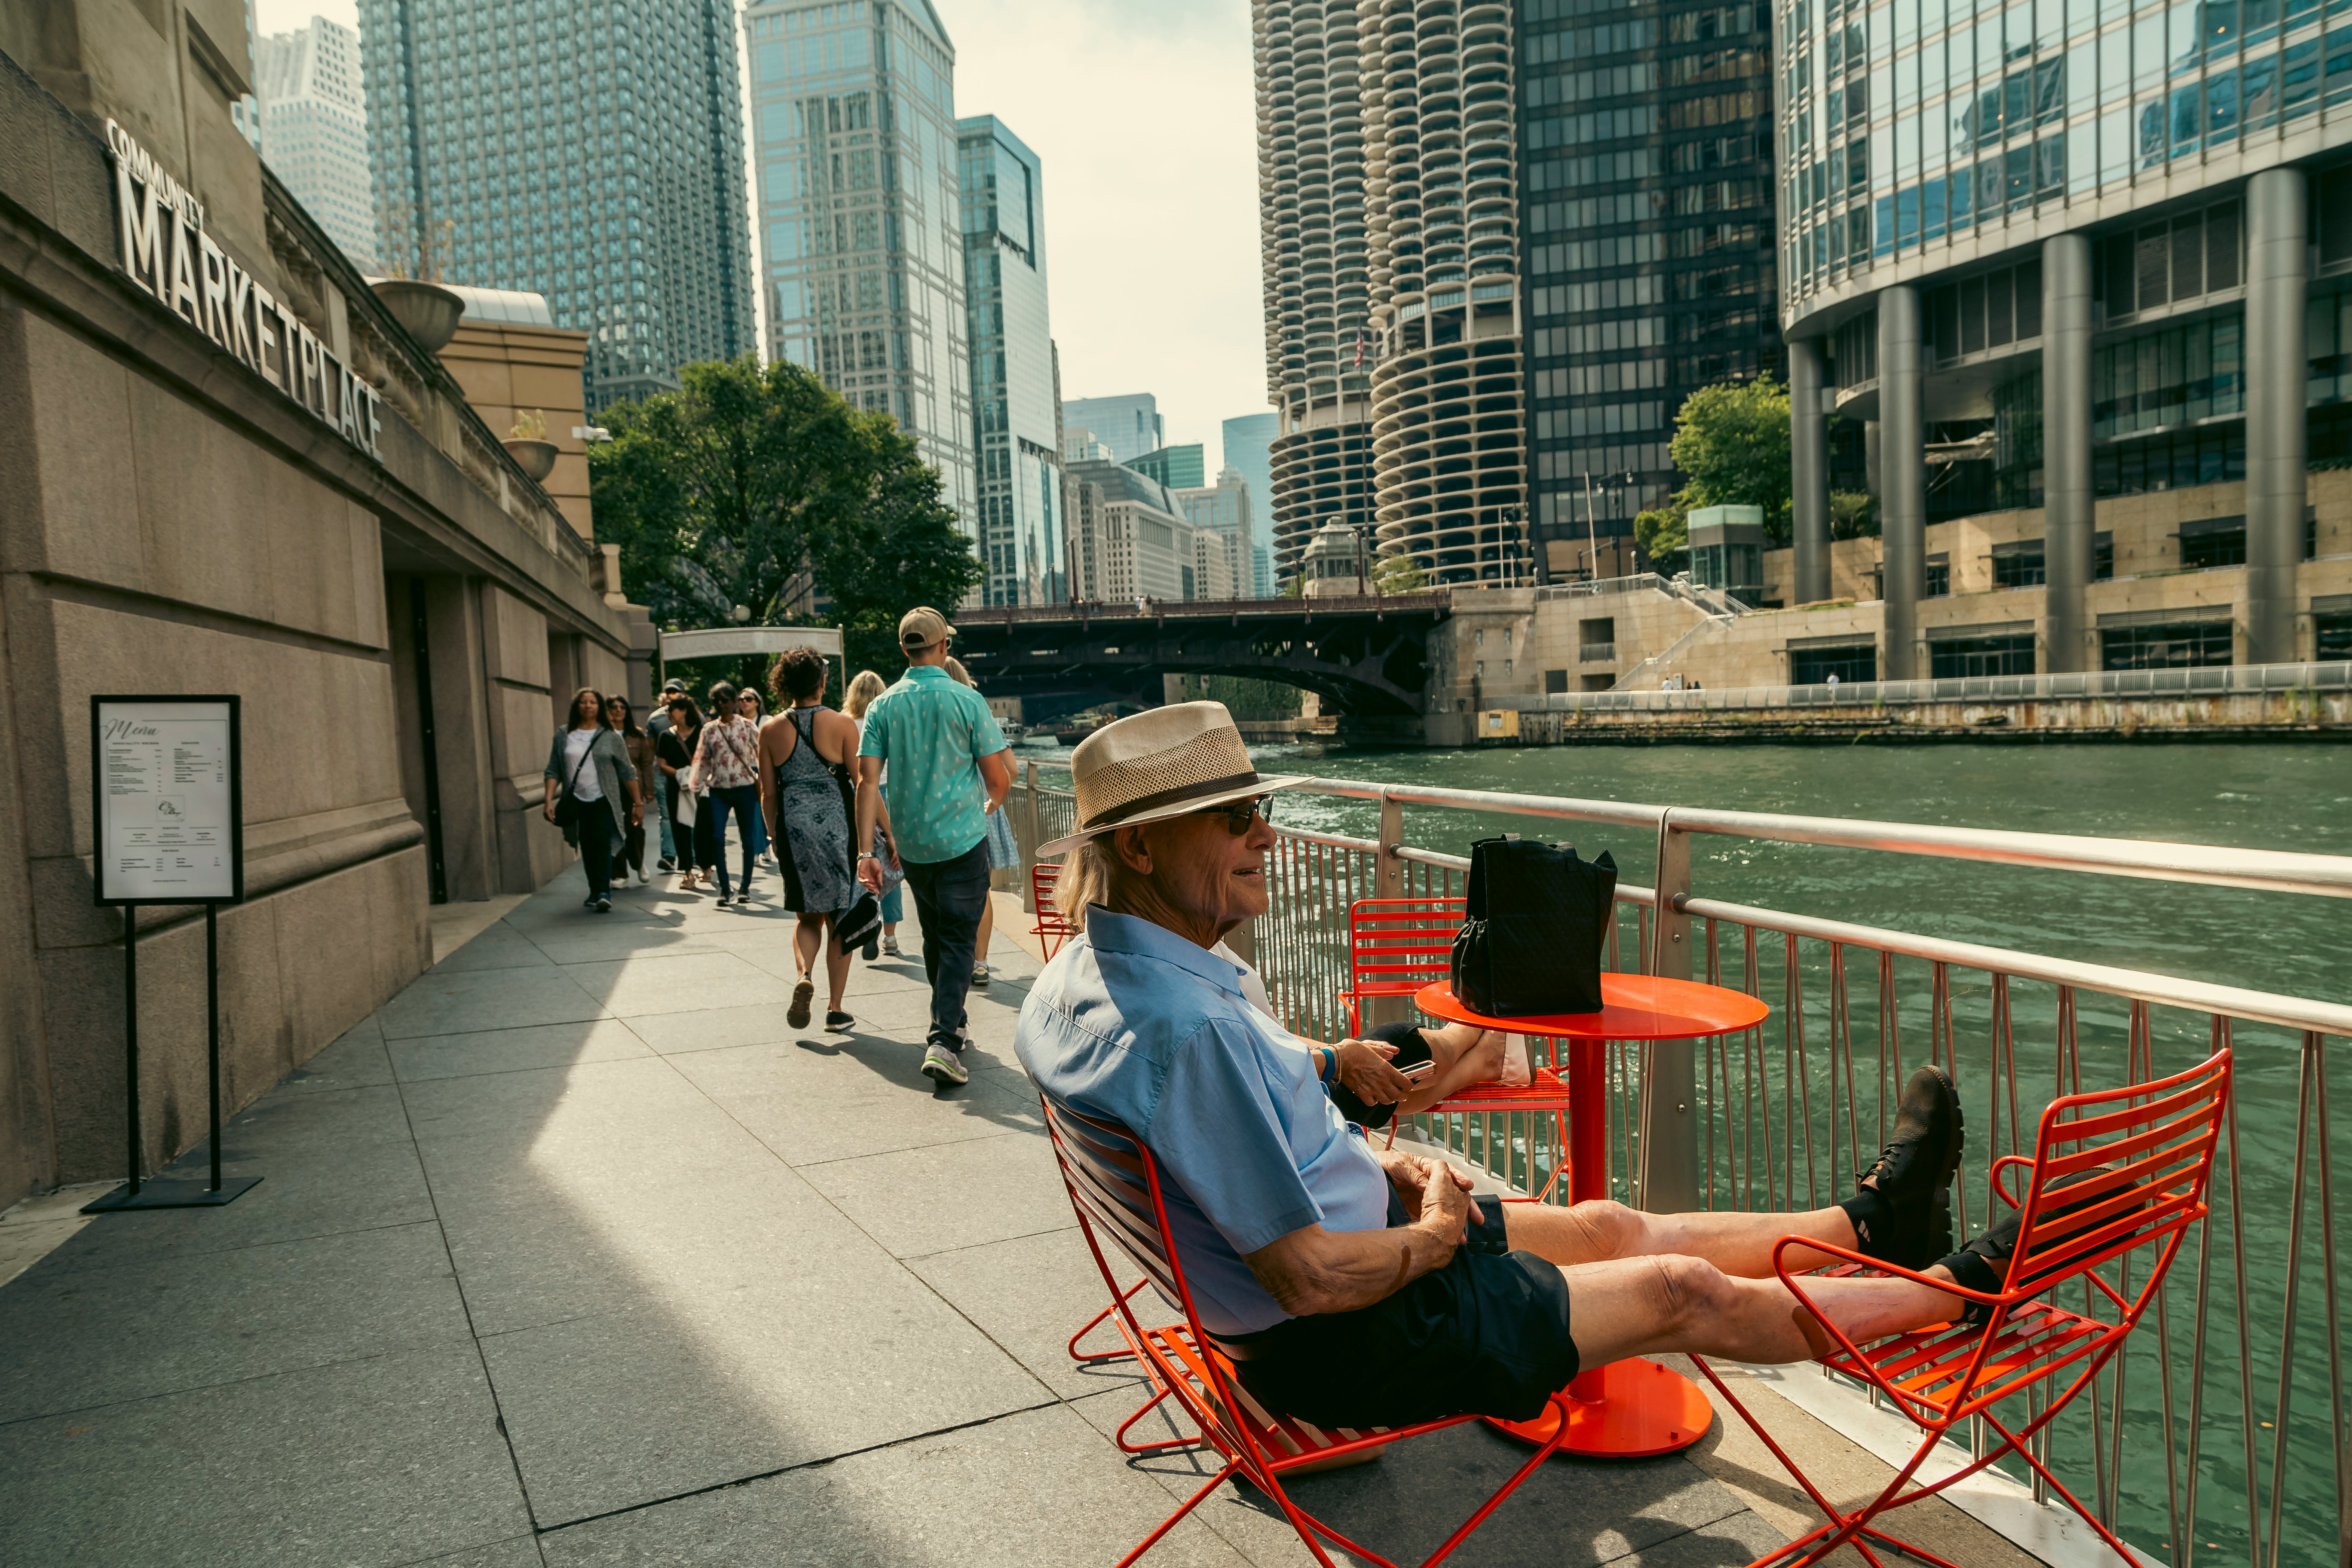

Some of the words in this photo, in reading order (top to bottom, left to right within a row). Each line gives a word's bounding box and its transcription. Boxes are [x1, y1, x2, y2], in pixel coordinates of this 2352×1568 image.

[107, 117, 204, 231] COMMUNITY
[116, 165, 383, 465] MARKETPLACE
[676, 634, 830, 654] MARKEPLAE
[101, 718, 157, 739] Menu
